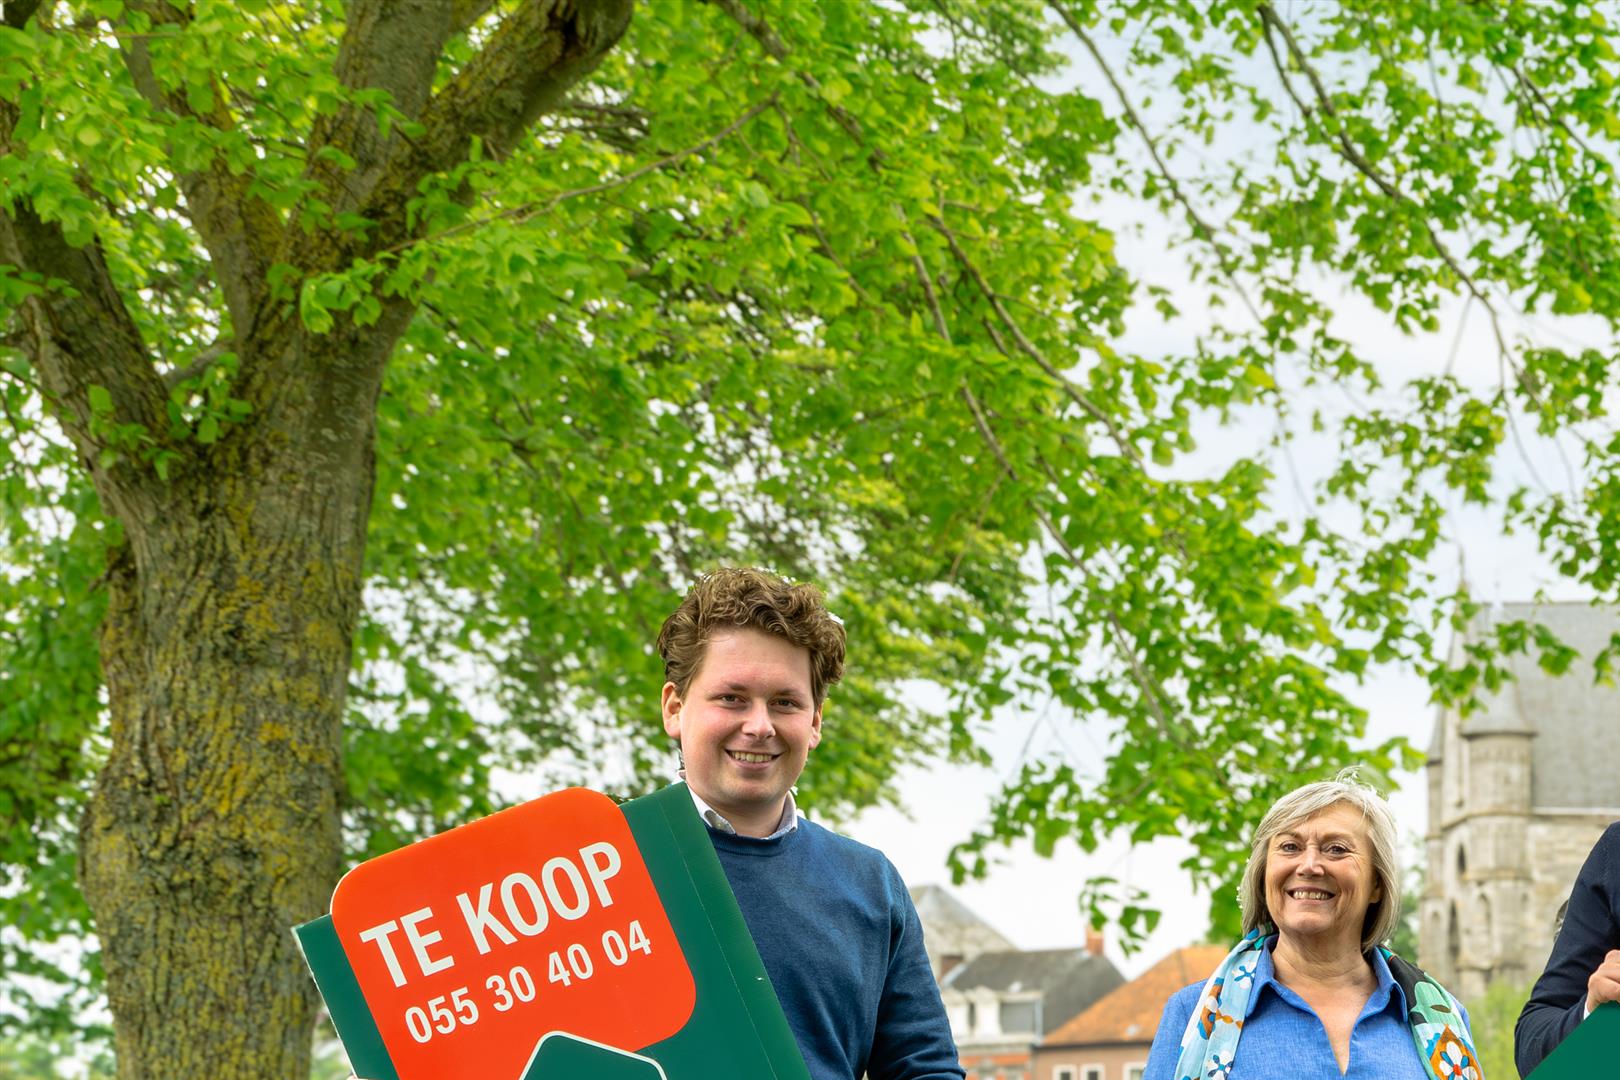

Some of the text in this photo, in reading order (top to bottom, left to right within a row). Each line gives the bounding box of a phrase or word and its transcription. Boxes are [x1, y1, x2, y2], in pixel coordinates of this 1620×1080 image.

[359, 841, 622, 988] TE KOOP
[405, 920, 652, 1044] 055 30 40 04
